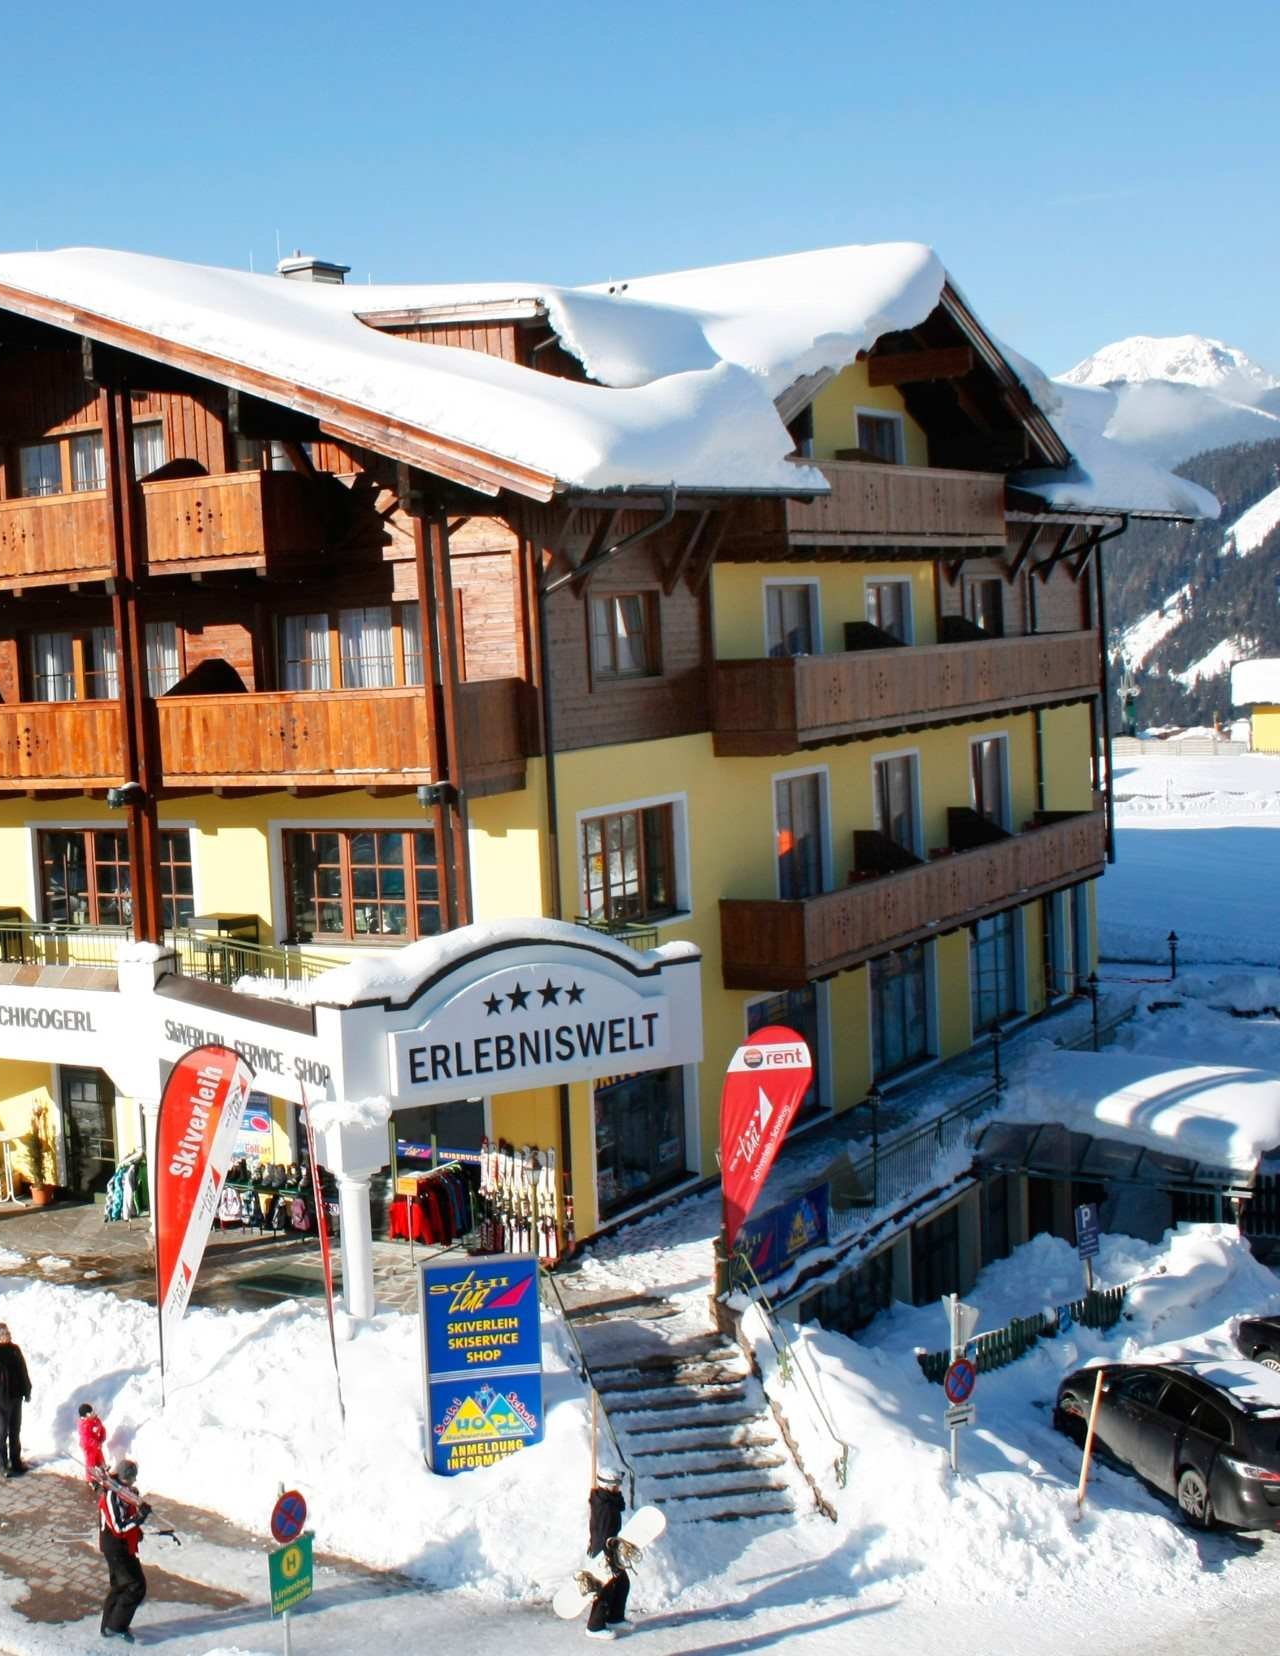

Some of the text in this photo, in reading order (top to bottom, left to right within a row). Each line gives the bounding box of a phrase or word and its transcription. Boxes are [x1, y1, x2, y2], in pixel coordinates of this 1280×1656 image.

[409, 1013, 659, 1084] ERLEBNISWELT
[766, 1048, 802, 1064] rent
[294, 1056, 331, 1088] SHOP
[169, 1065, 224, 1179] Skiverleih
[1081, 1207, 1091, 1229] P
[429, 1277, 509, 1295] SCHI
[448, 1270, 491, 1314] Lenz
[447, 1317, 518, 1335] SKIVERLEIH
[448, 1333, 519, 1350] SKISERVICE
[466, 1349, 502, 1364] SHOP
[451, 1439, 524, 1458] ANMELDUNG
[447, 1452, 514, 1470] INFORMA
[286, 1552, 296, 1572] H
